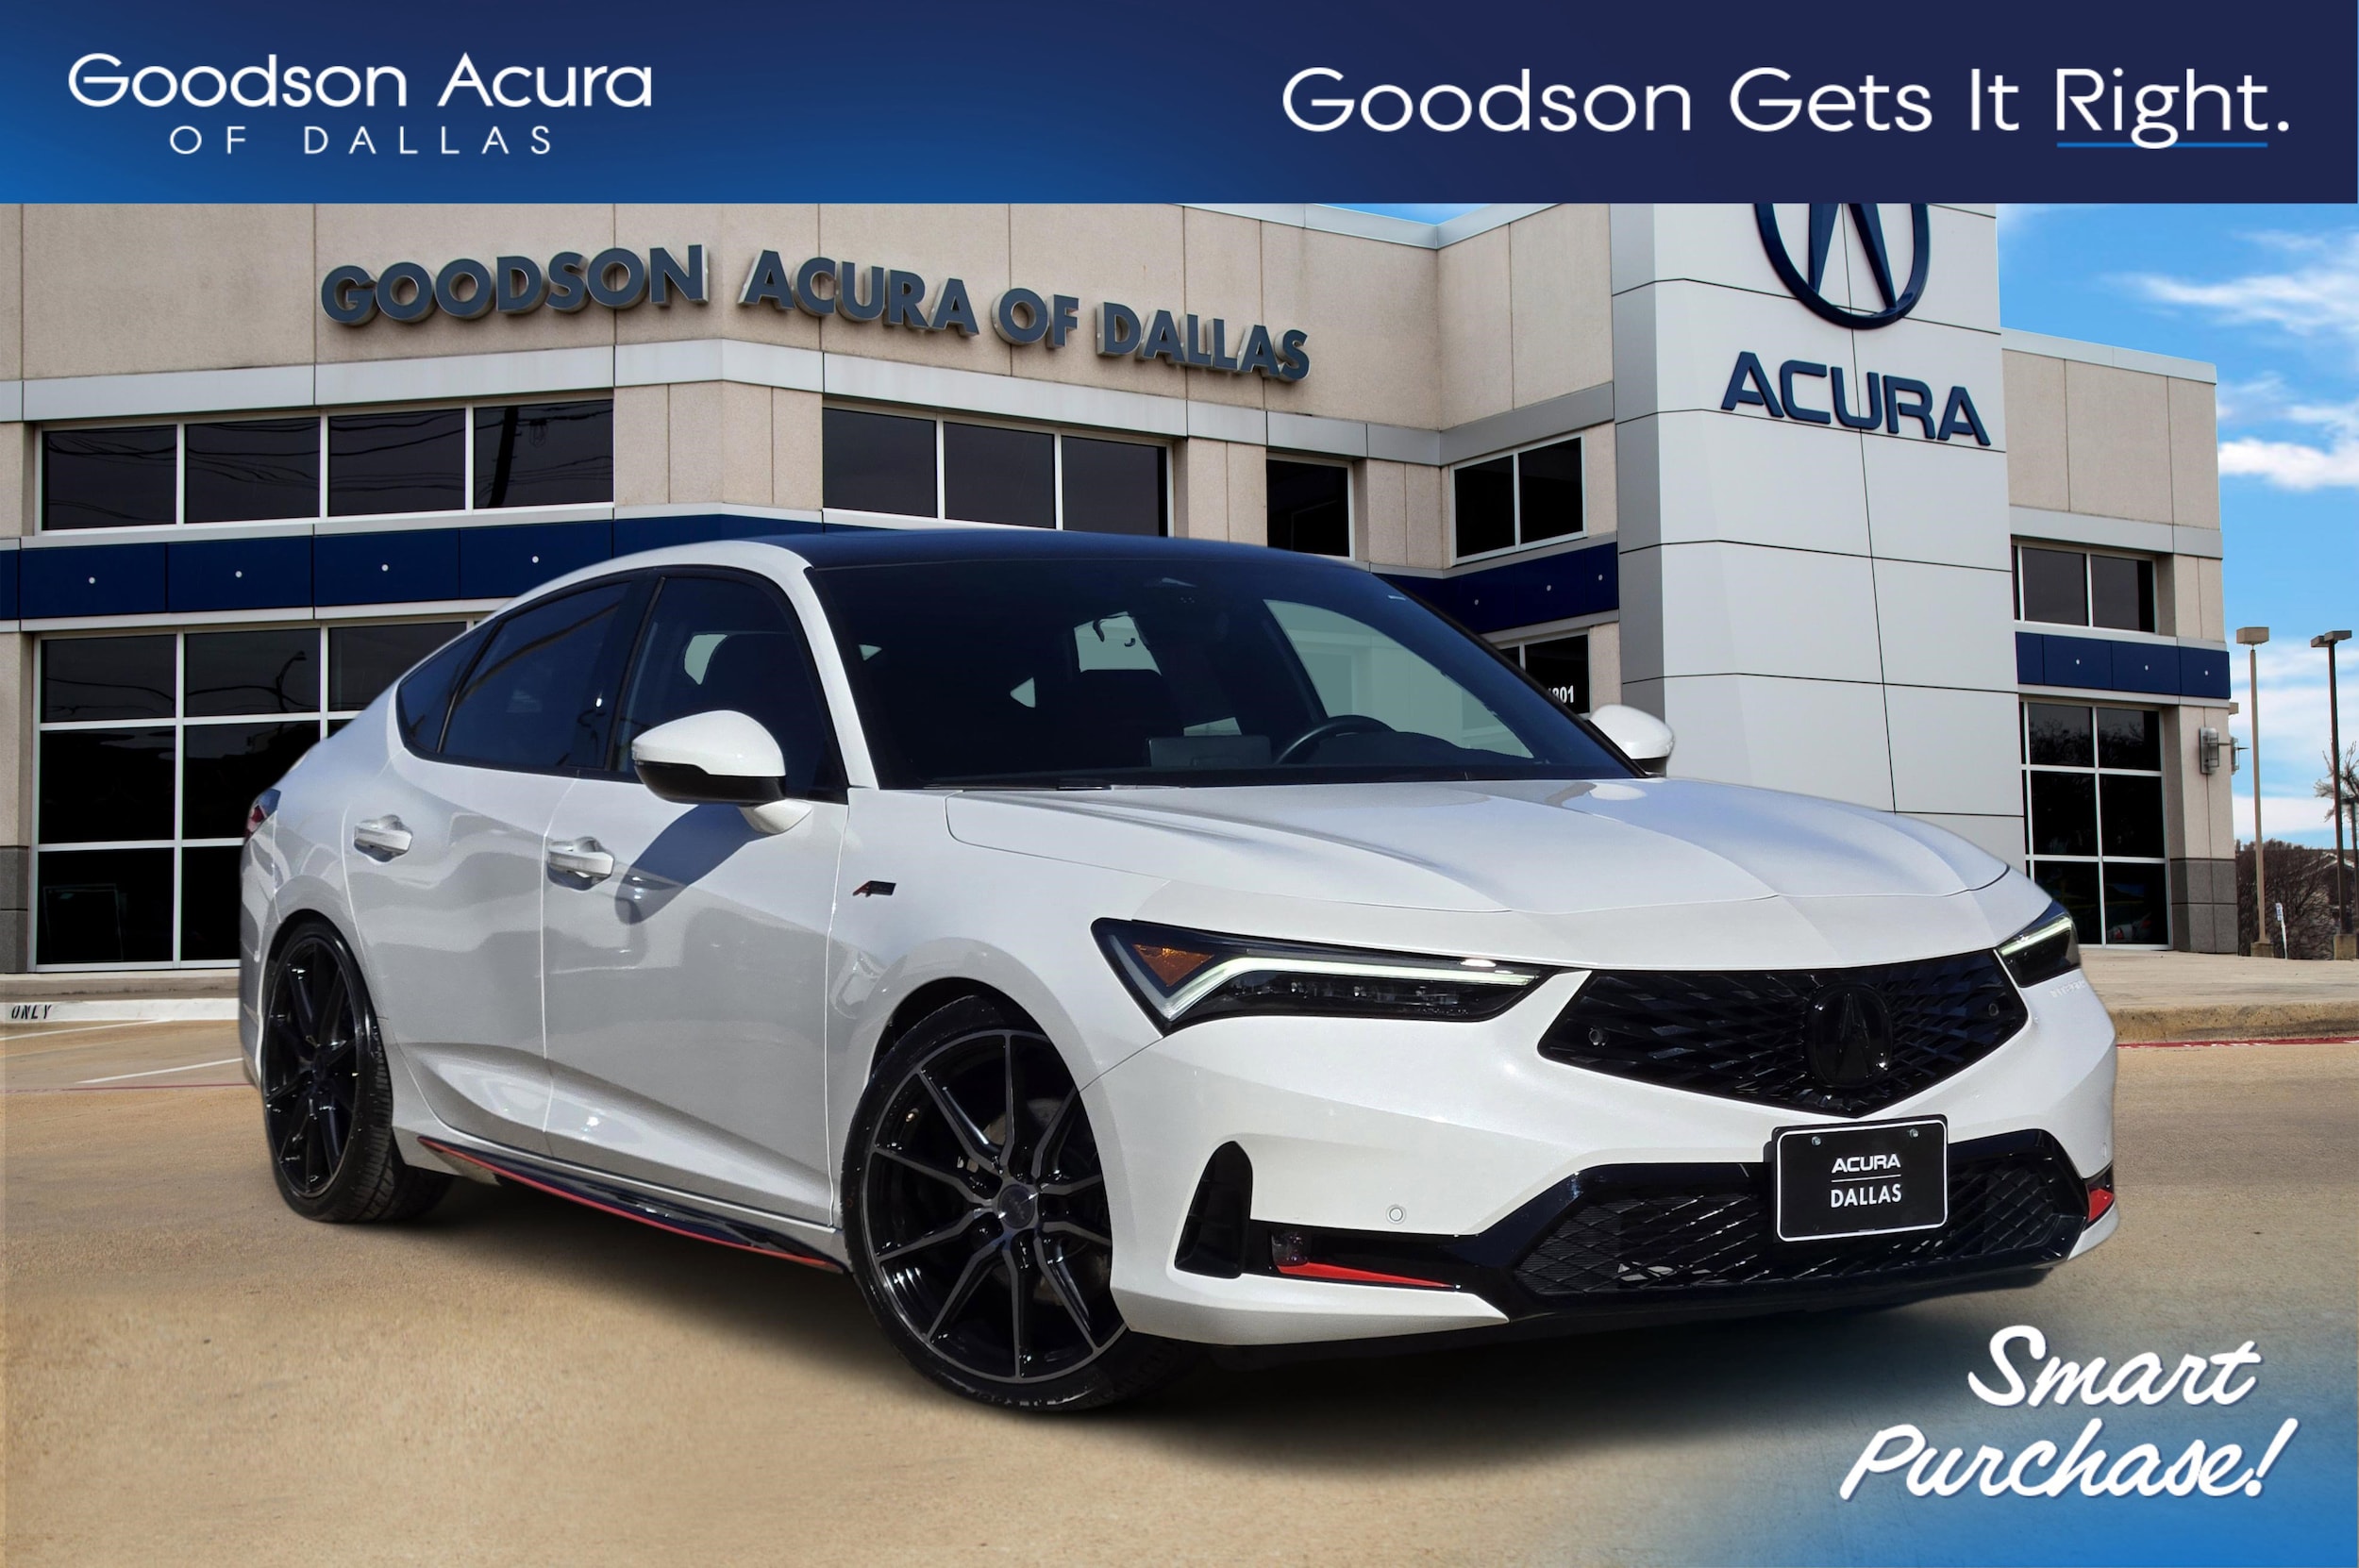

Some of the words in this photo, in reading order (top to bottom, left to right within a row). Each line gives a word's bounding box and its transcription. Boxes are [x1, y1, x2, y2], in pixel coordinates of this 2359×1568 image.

[321, 243, 710, 327] GOODSON
[738, 249, 979, 338] ACURA
[991, 287, 1079, 350] OF
[1095, 301, 1311, 382] DALLAS
[1720, 350, 1992, 447] ACURA
[10, 1004, 52, 1020] ONLY
[1831, 1153, 1901, 1174] ACURA
[1831, 1183, 1902, 1209] DALLAS
